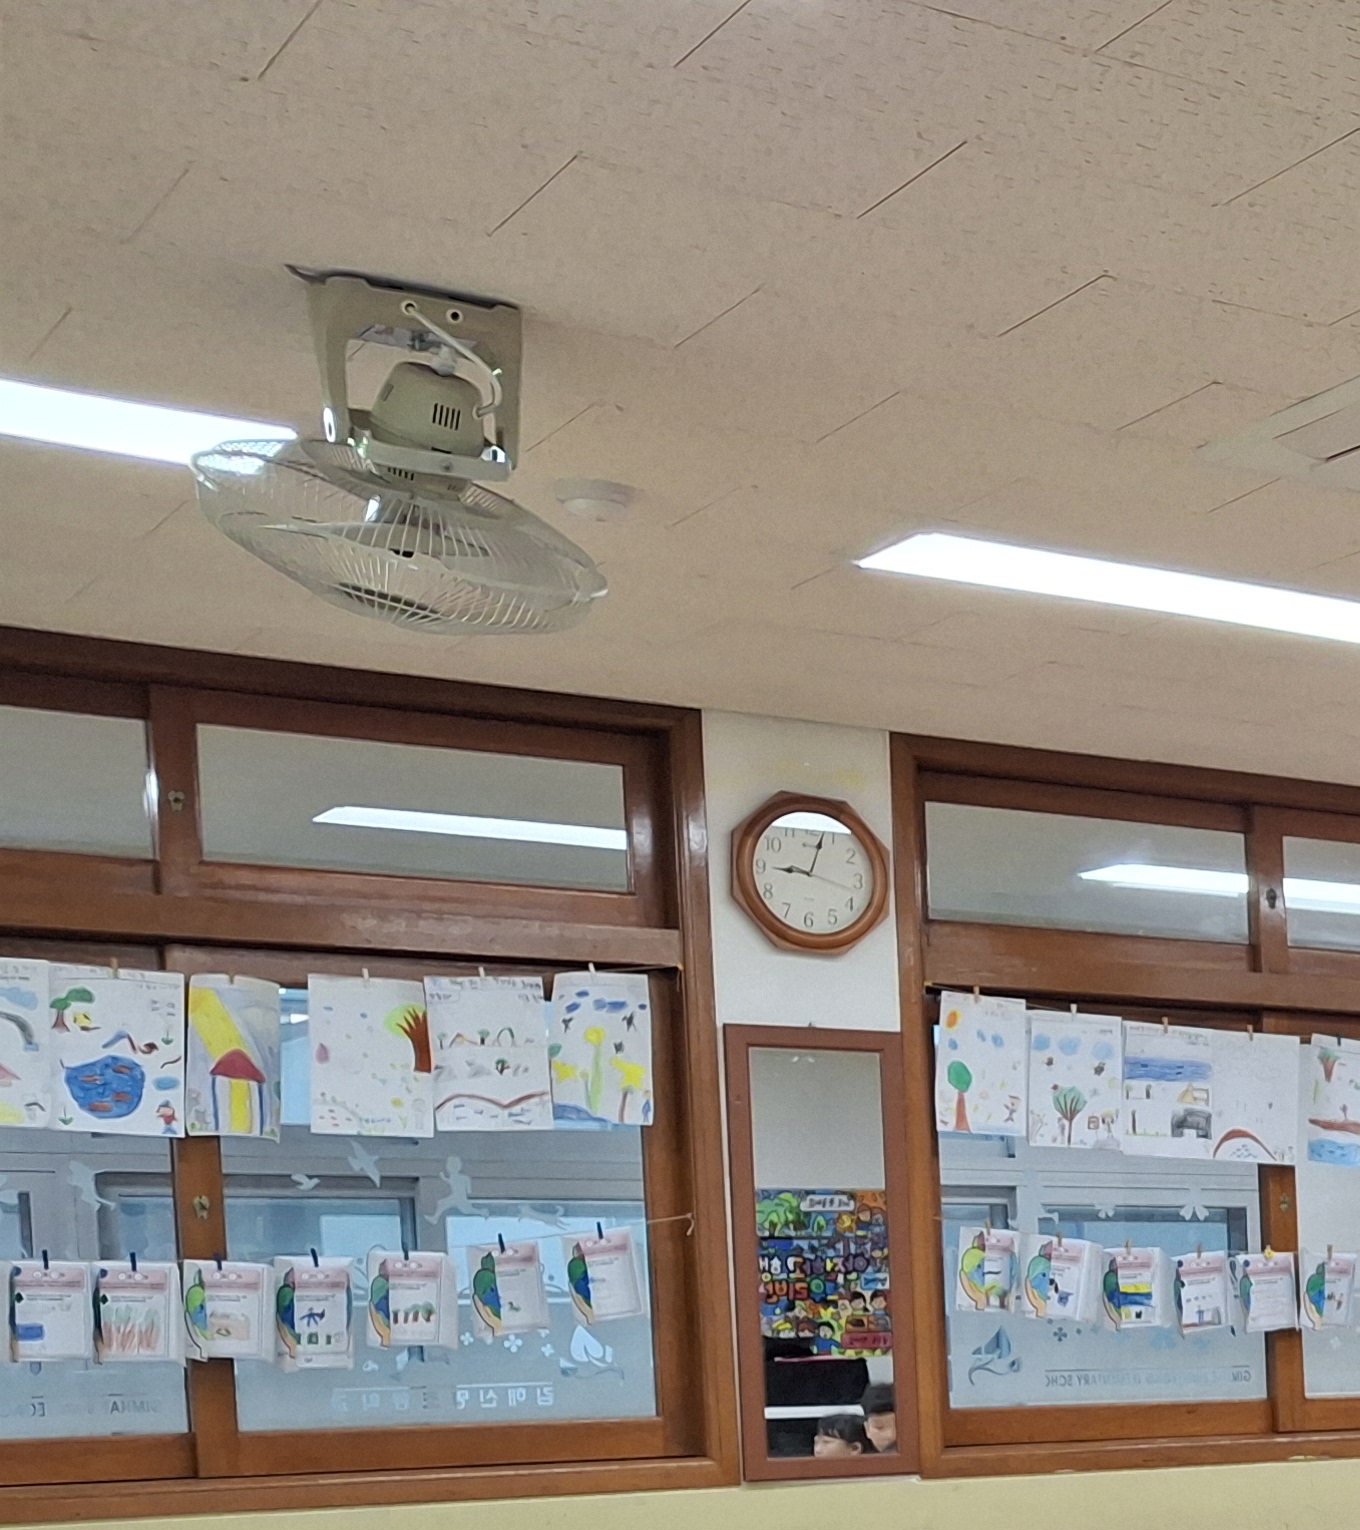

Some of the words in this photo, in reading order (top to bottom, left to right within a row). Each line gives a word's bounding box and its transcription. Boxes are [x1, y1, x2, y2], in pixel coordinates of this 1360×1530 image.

[764, 836, 782, 853] 10
[845, 848, 856, 865] 2
[755, 859, 767, 875] 9
[853, 873, 864, 890] 3
[762, 883, 774, 900] 8
[781, 902, 792, 919] 7
[845, 896, 854, 912] 4
[803, 912, 814, 928] 6
[827, 908, 838, 925] 5
